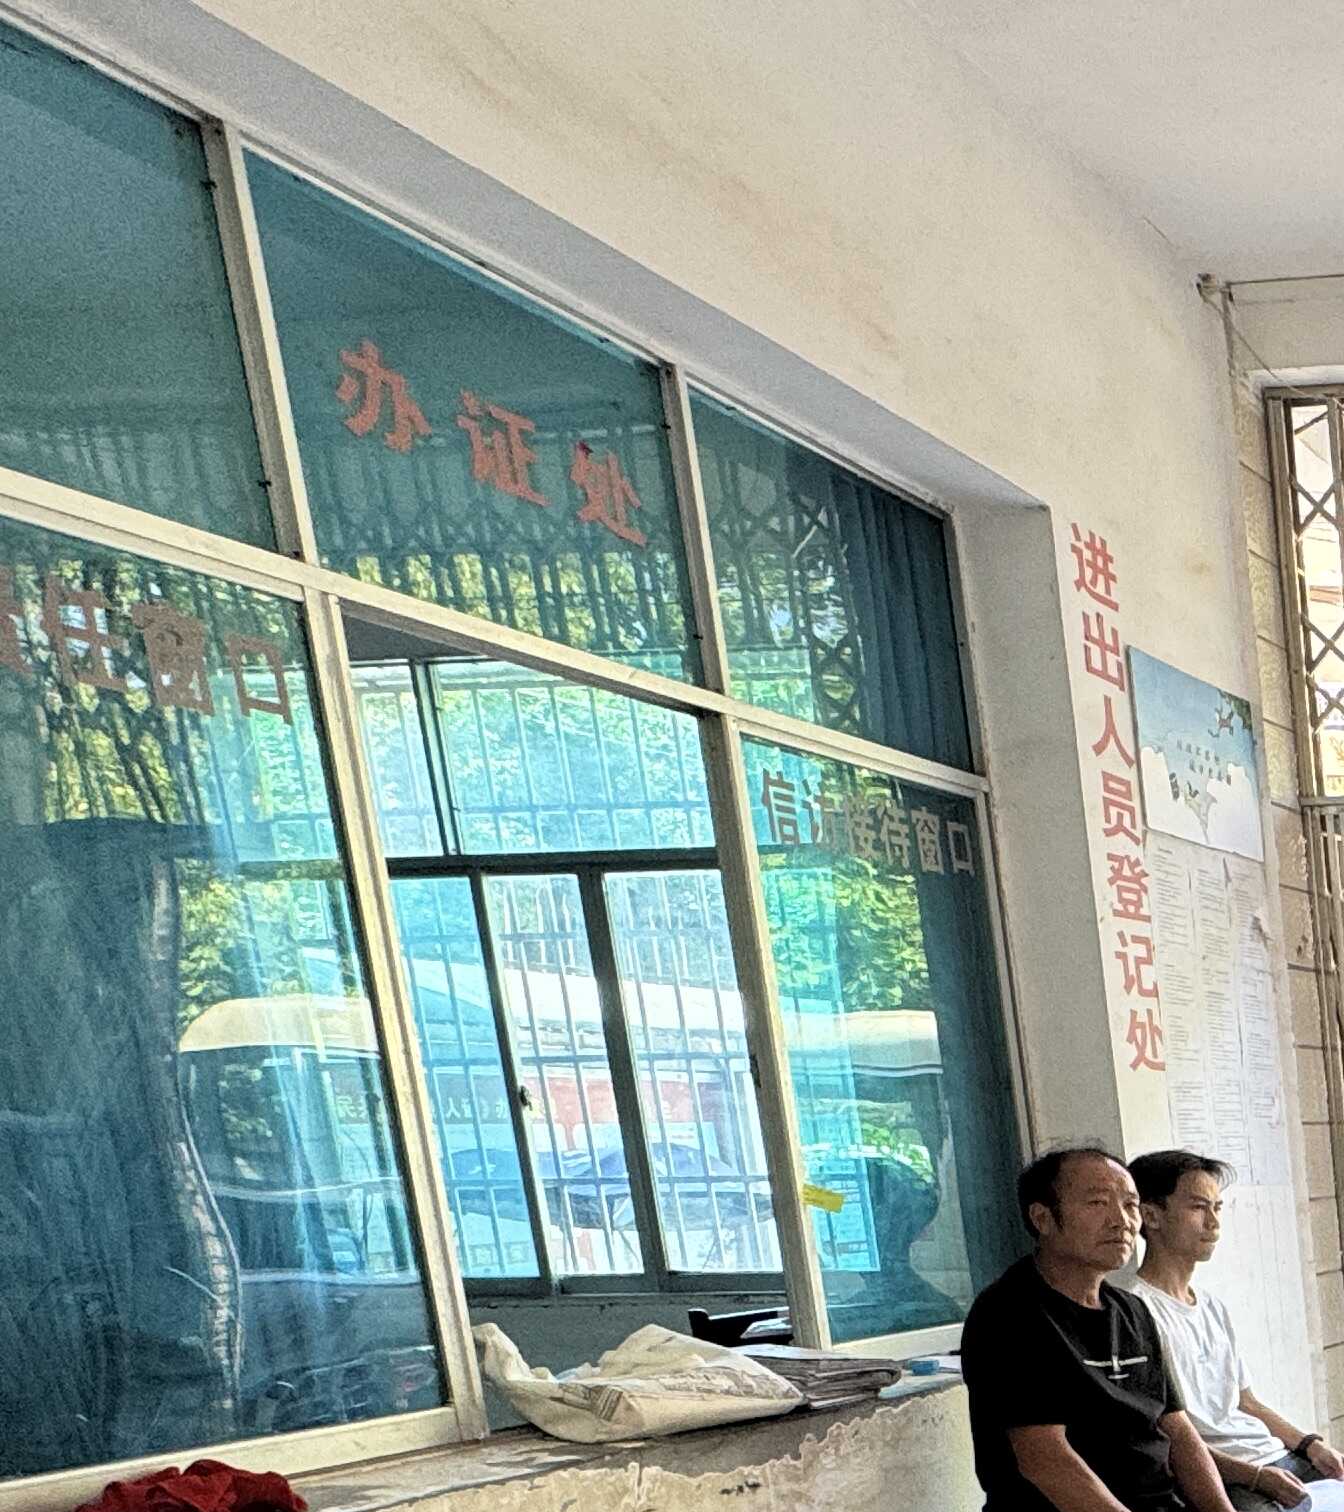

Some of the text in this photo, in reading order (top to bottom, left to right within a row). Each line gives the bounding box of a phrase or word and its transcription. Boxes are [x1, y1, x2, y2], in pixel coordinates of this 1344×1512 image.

[334, 337, 648, 548] 办证处
[761, 767, 976, 877] 信访接待窗口
[1070, 522, 1166, 1072] 进出人员登记处
